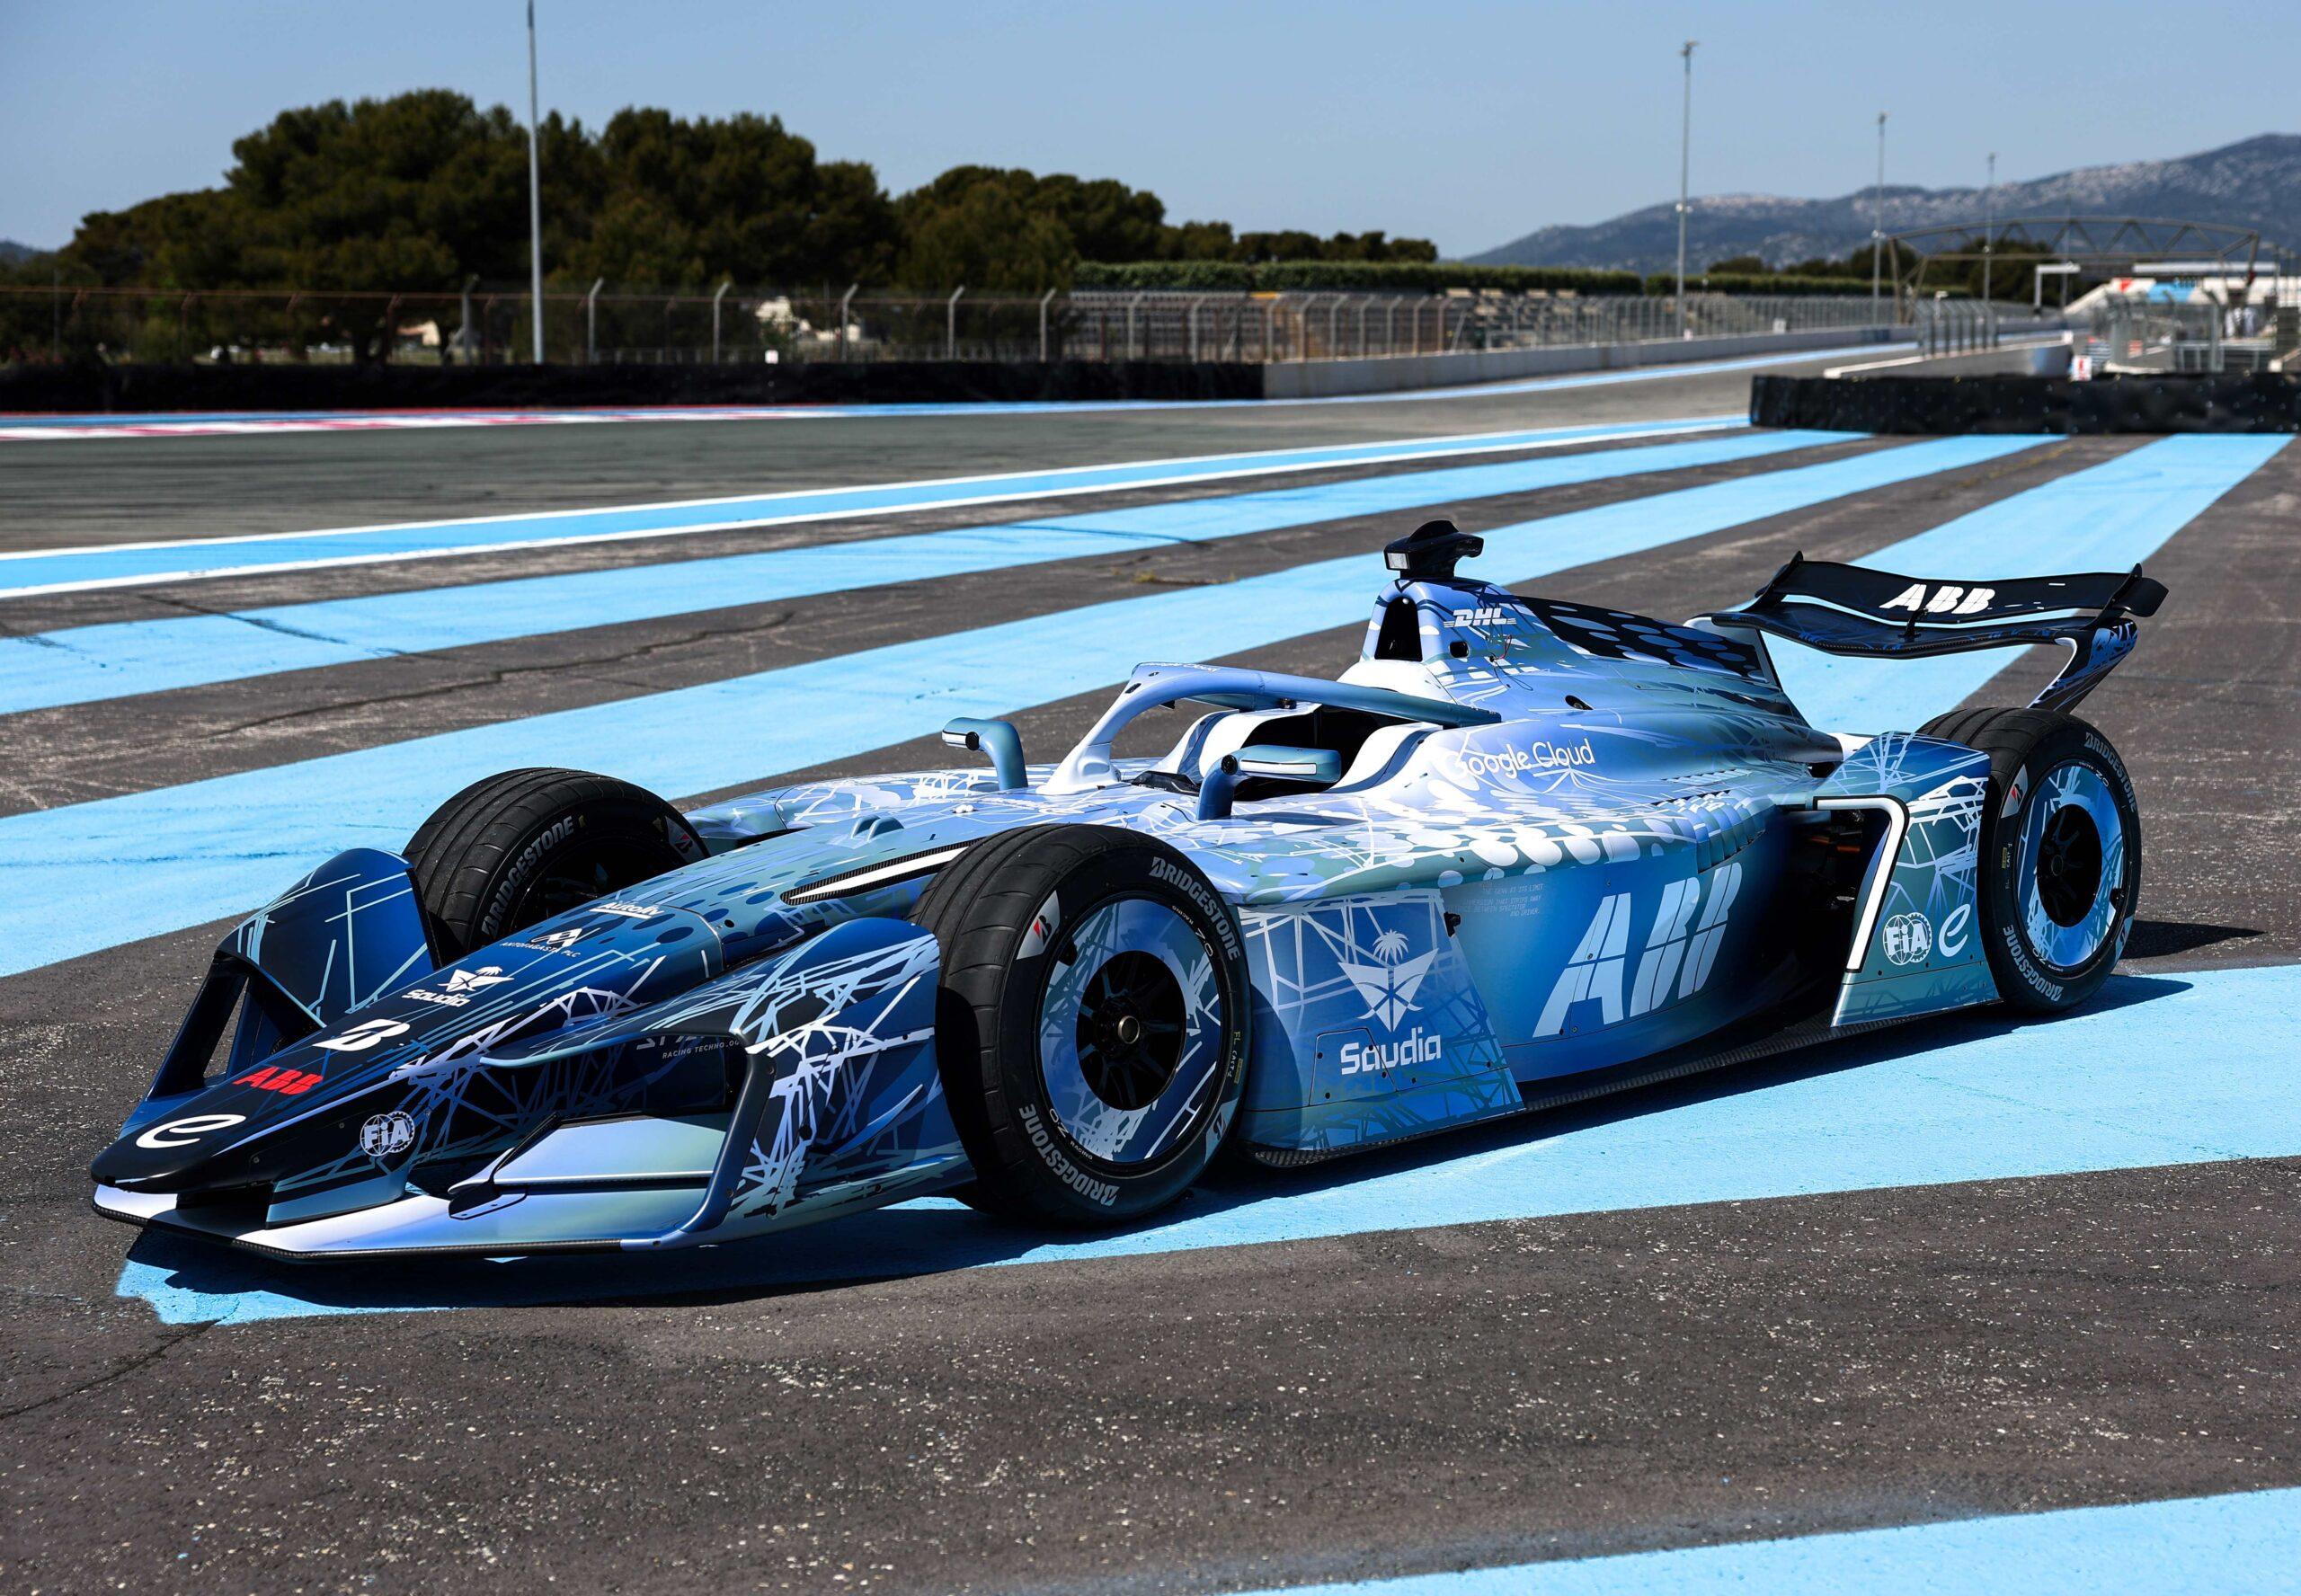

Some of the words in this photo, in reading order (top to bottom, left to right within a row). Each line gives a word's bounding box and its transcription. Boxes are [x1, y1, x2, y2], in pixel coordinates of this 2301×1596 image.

[1879, 583, 1995, 614] ABB
[1453, 607, 1507, 627] DHL
[1533, 738, 1595, 767] Cloud
[2084, 732, 2137, 812] BRIDGESTONE
[481, 815, 574, 938] BRIDGESTONE
[599, 901, 664, 916] Autoliv
[1149, 856, 1240, 961] BRIDGESTONE
[561, 949, 582, 958] PLC
[1532, 862, 1742, 1038] ABB
[2003, 924, 2064, 1002] BRIDGESTONE
[402, 989, 471, 1007] Saudia
[662, 1047, 691, 1060] RACING
[1340, 1026, 1441, 1075] Saudia
[232, 1066, 324, 1095] ABB
[1018, 1104, 1120, 1206] BRIDGESTONE
[1070, 1140, 1093, 1160] RACING
